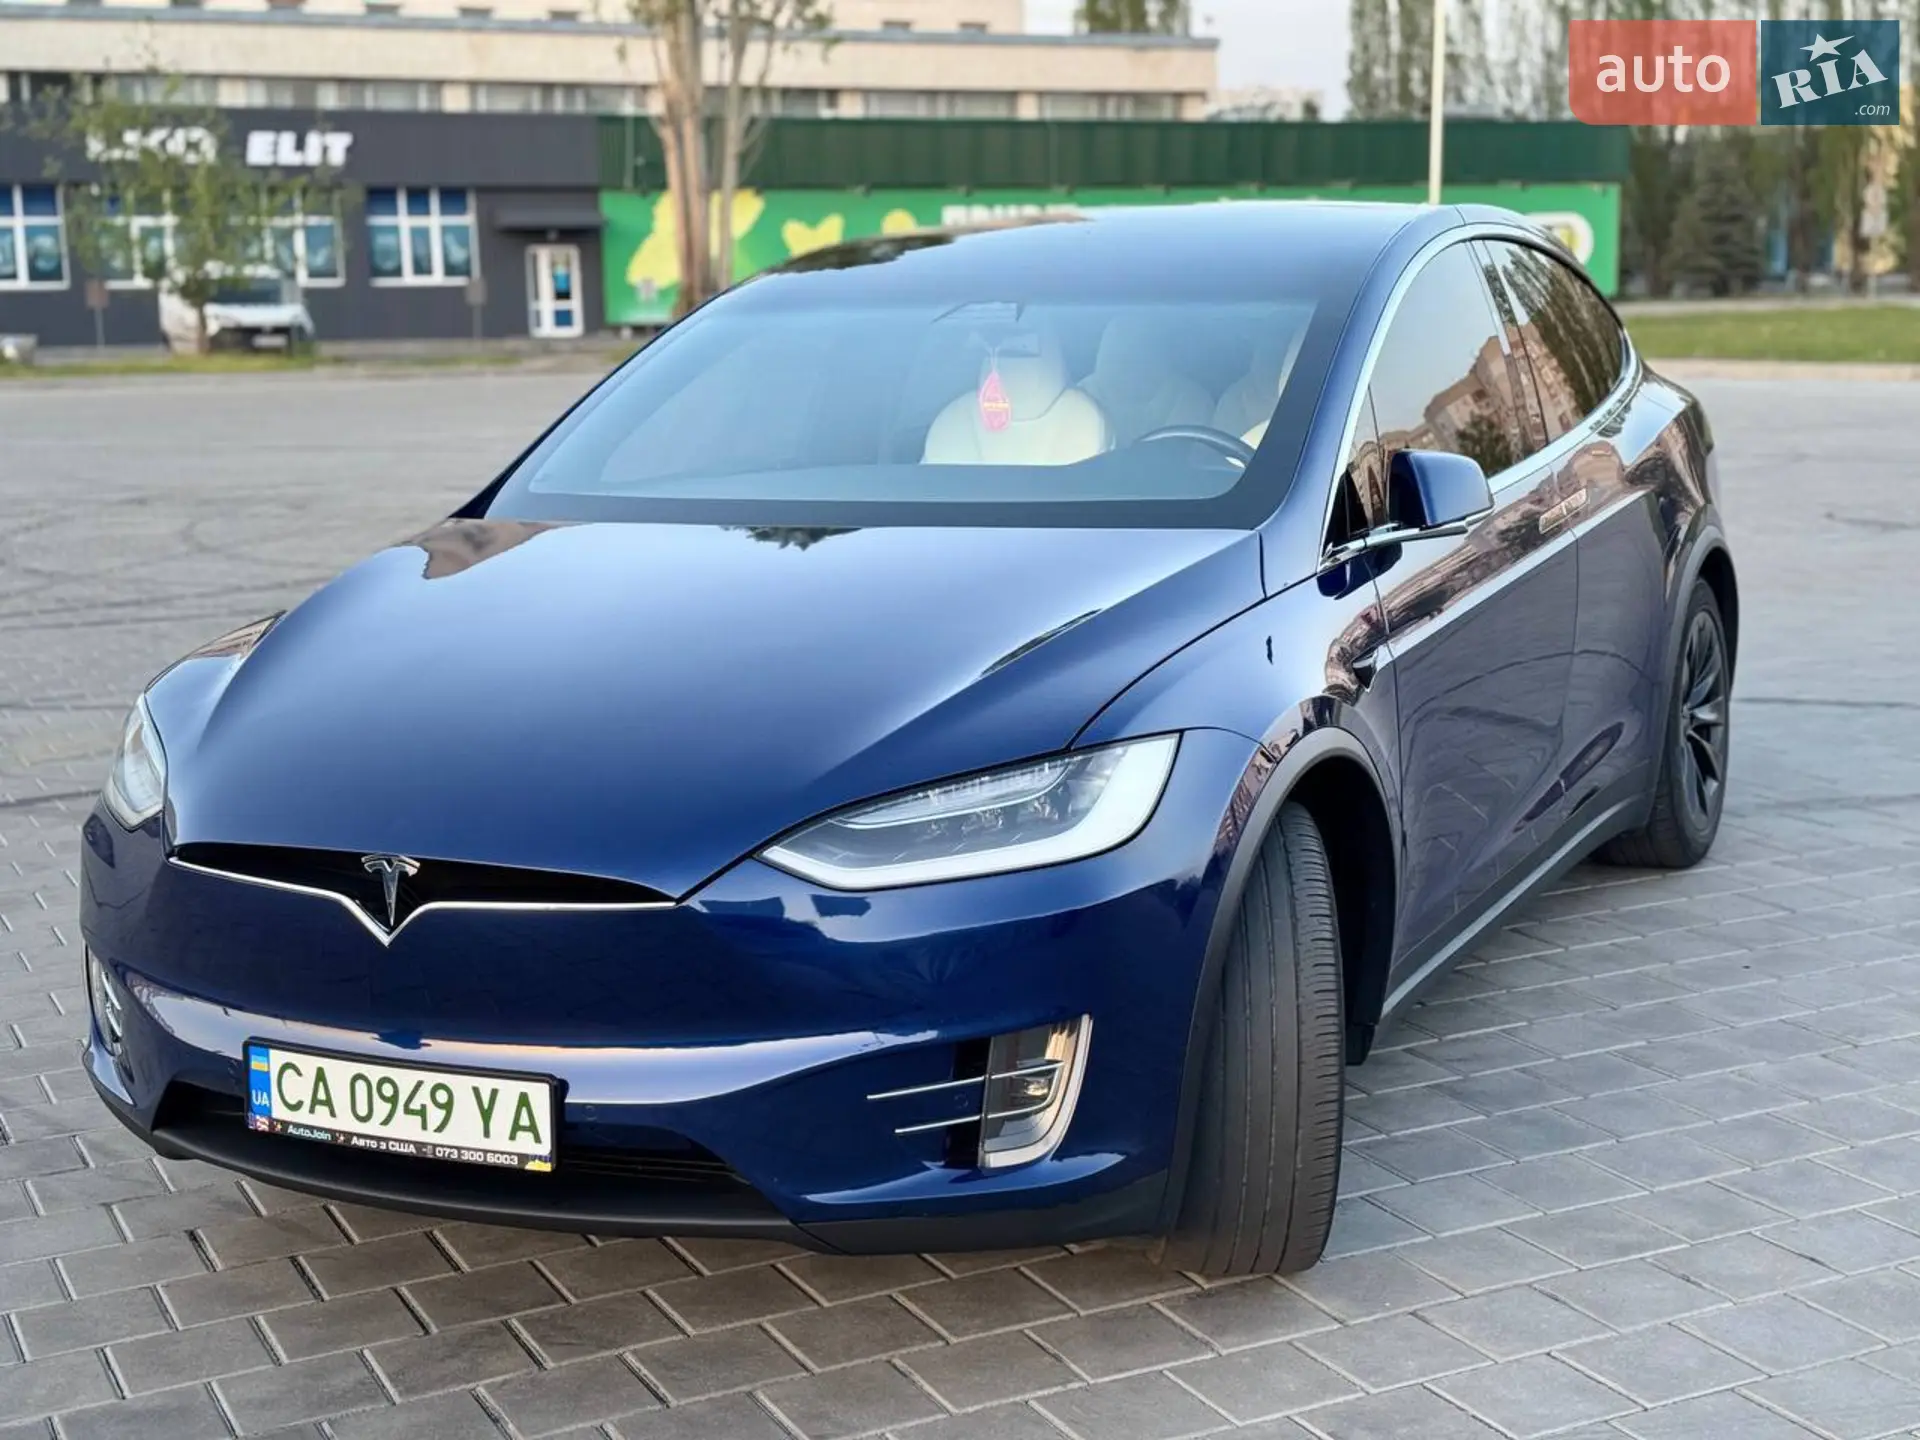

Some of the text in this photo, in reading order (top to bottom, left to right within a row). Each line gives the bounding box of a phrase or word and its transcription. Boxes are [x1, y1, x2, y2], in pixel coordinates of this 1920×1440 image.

[246, 130, 353, 167] ELIT
[251, 1089, 270, 1107] UA
[277, 1061, 542, 1144] CA 0949 YA
[287, 1124, 331, 1141] AutoJoin
[351, 1135, 378, 1149] Авто
[388, 1140, 417, 1154] США
[435, 1146, 518, 1165] 073 300 6003
